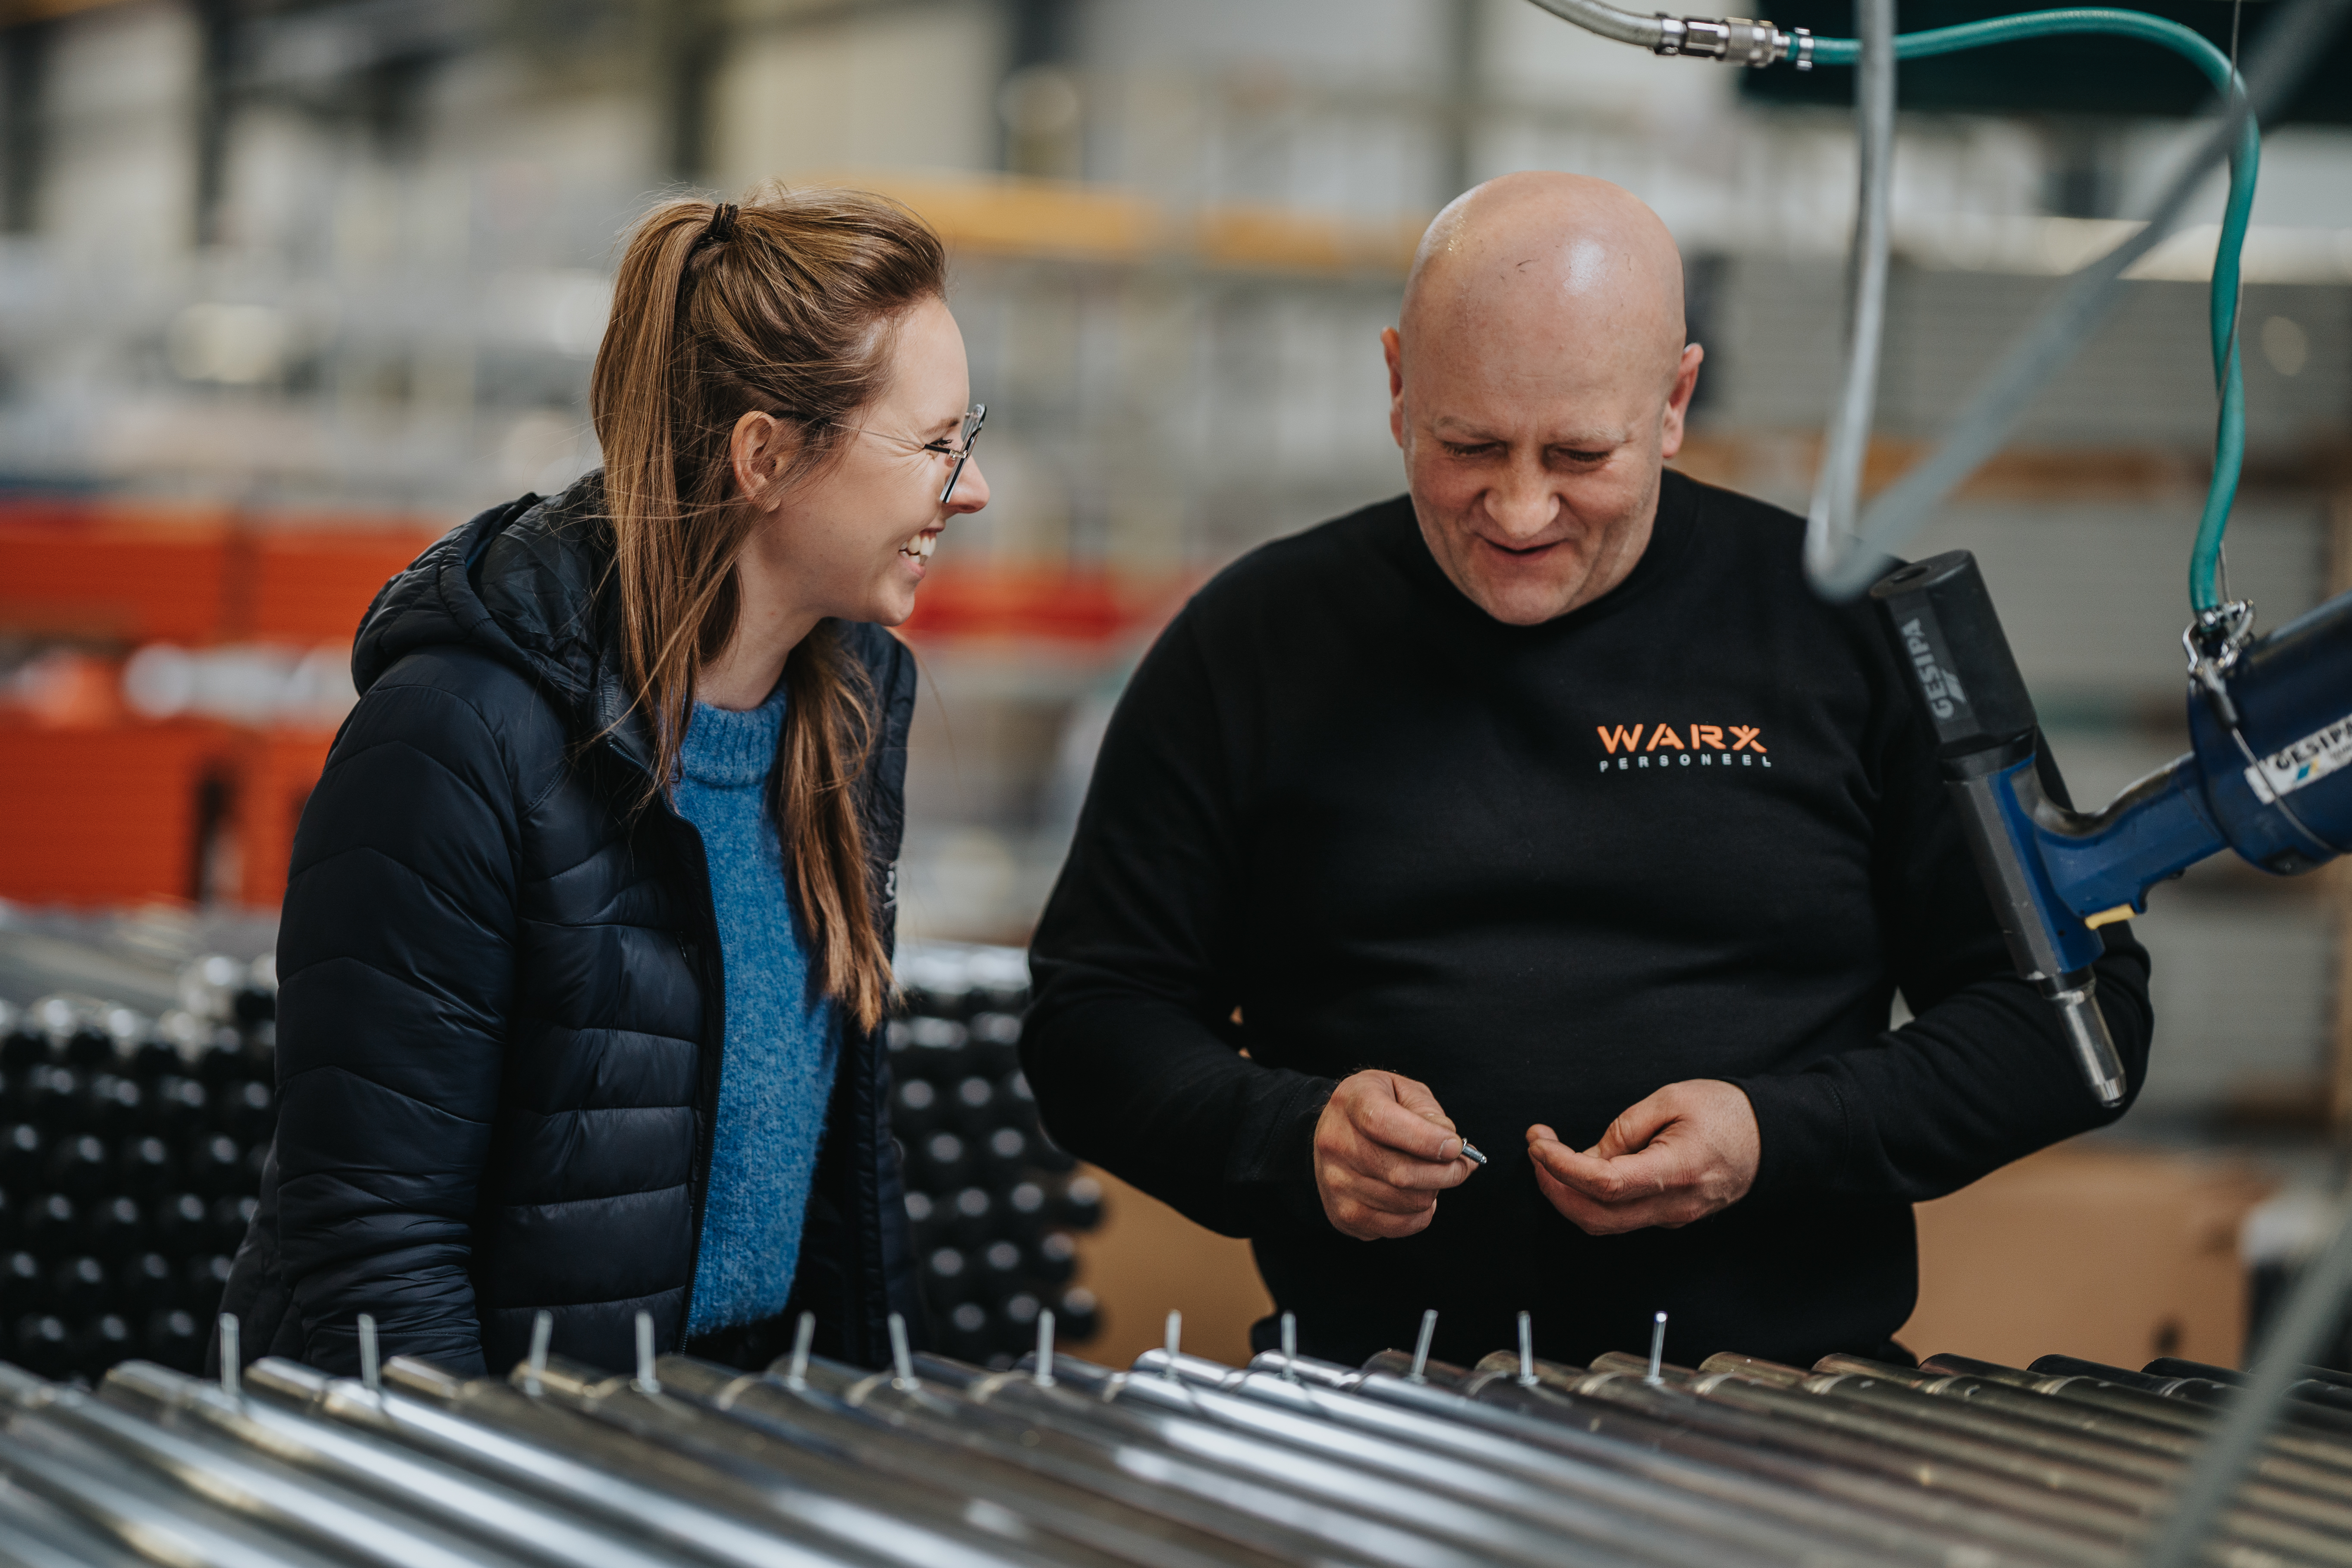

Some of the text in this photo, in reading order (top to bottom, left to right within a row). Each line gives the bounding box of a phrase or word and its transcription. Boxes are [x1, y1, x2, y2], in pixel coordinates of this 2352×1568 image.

[1902, 618, 1954, 718] GESIPA
[1597, 723, 1767, 754] WARX
[1599, 754, 1771, 772] PERSONEEL
